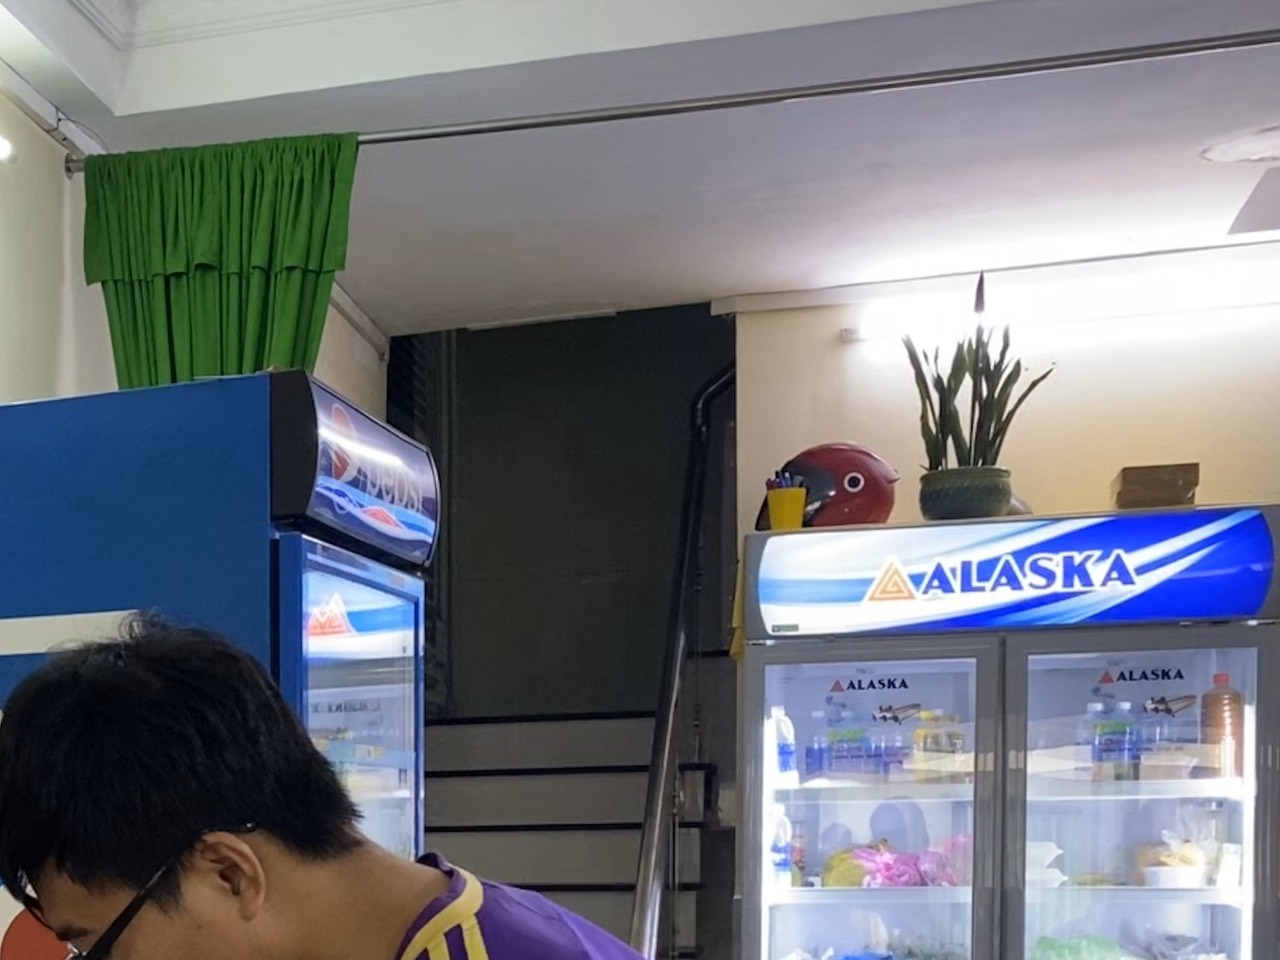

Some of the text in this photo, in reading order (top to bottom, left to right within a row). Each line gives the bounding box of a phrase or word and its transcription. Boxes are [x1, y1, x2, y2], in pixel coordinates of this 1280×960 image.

[921, 552, 1137, 595] ALASKA
[1116, 668, 1185, 682] ALASKA
[846, 678, 909, 691] ALASKA
